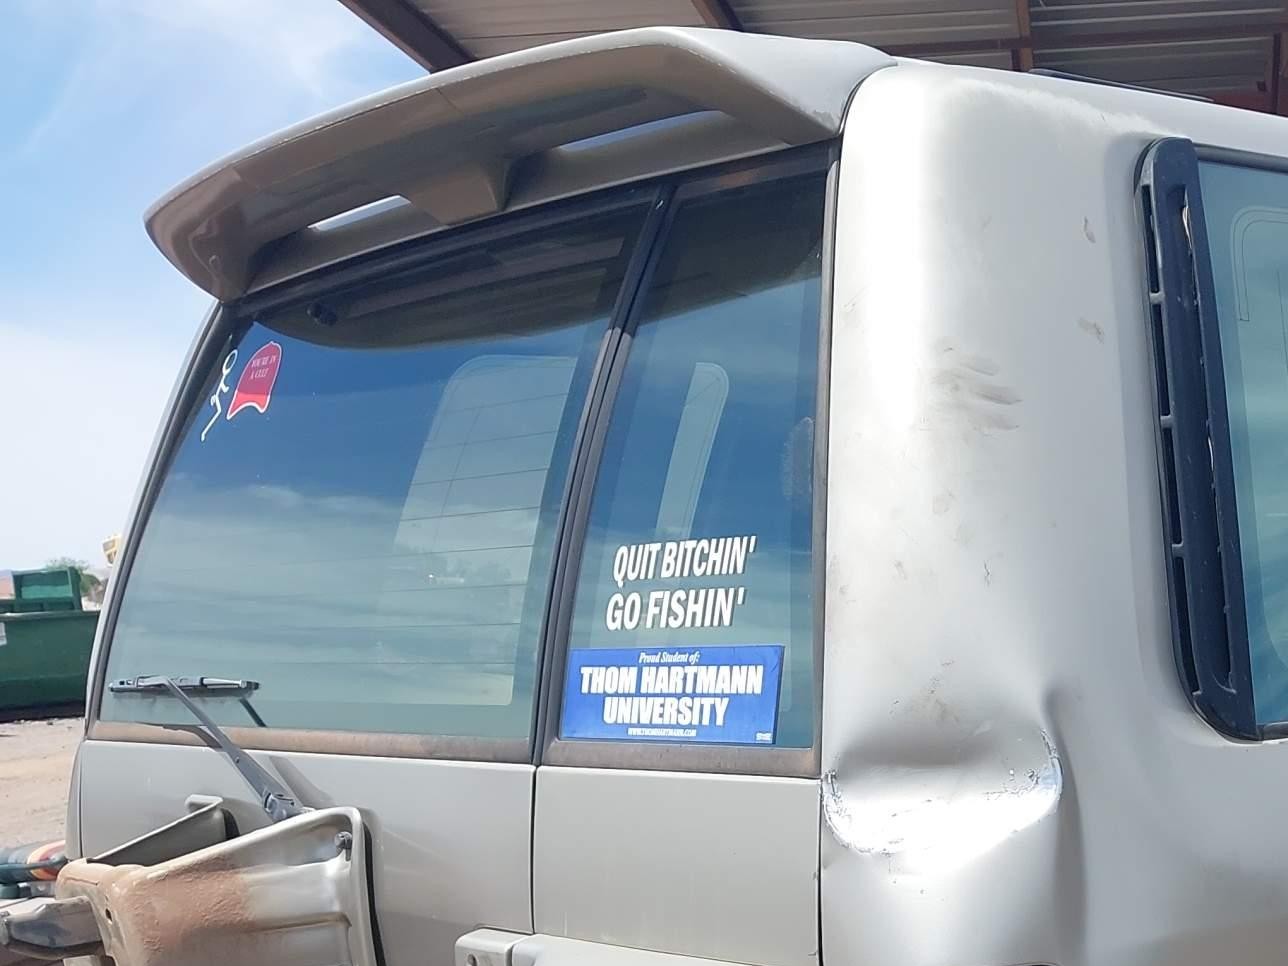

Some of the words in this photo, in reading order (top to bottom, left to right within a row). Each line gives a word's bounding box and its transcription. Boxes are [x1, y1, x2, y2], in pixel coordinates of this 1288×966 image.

[613, 542, 662, 587] QUIT
[661, 535, 756, 579] BITCHIN'
[606, 592, 642, 631] GO
[646, 587, 746, 629] FISHIN'
[639, 651, 661, 663] Proud
[661, 651, 688, 663] Student
[580, 666, 638, 694] THOM
[640, 665, 764, 694] HARTMANN
[603, 697, 729, 726] UNIVERSITY
